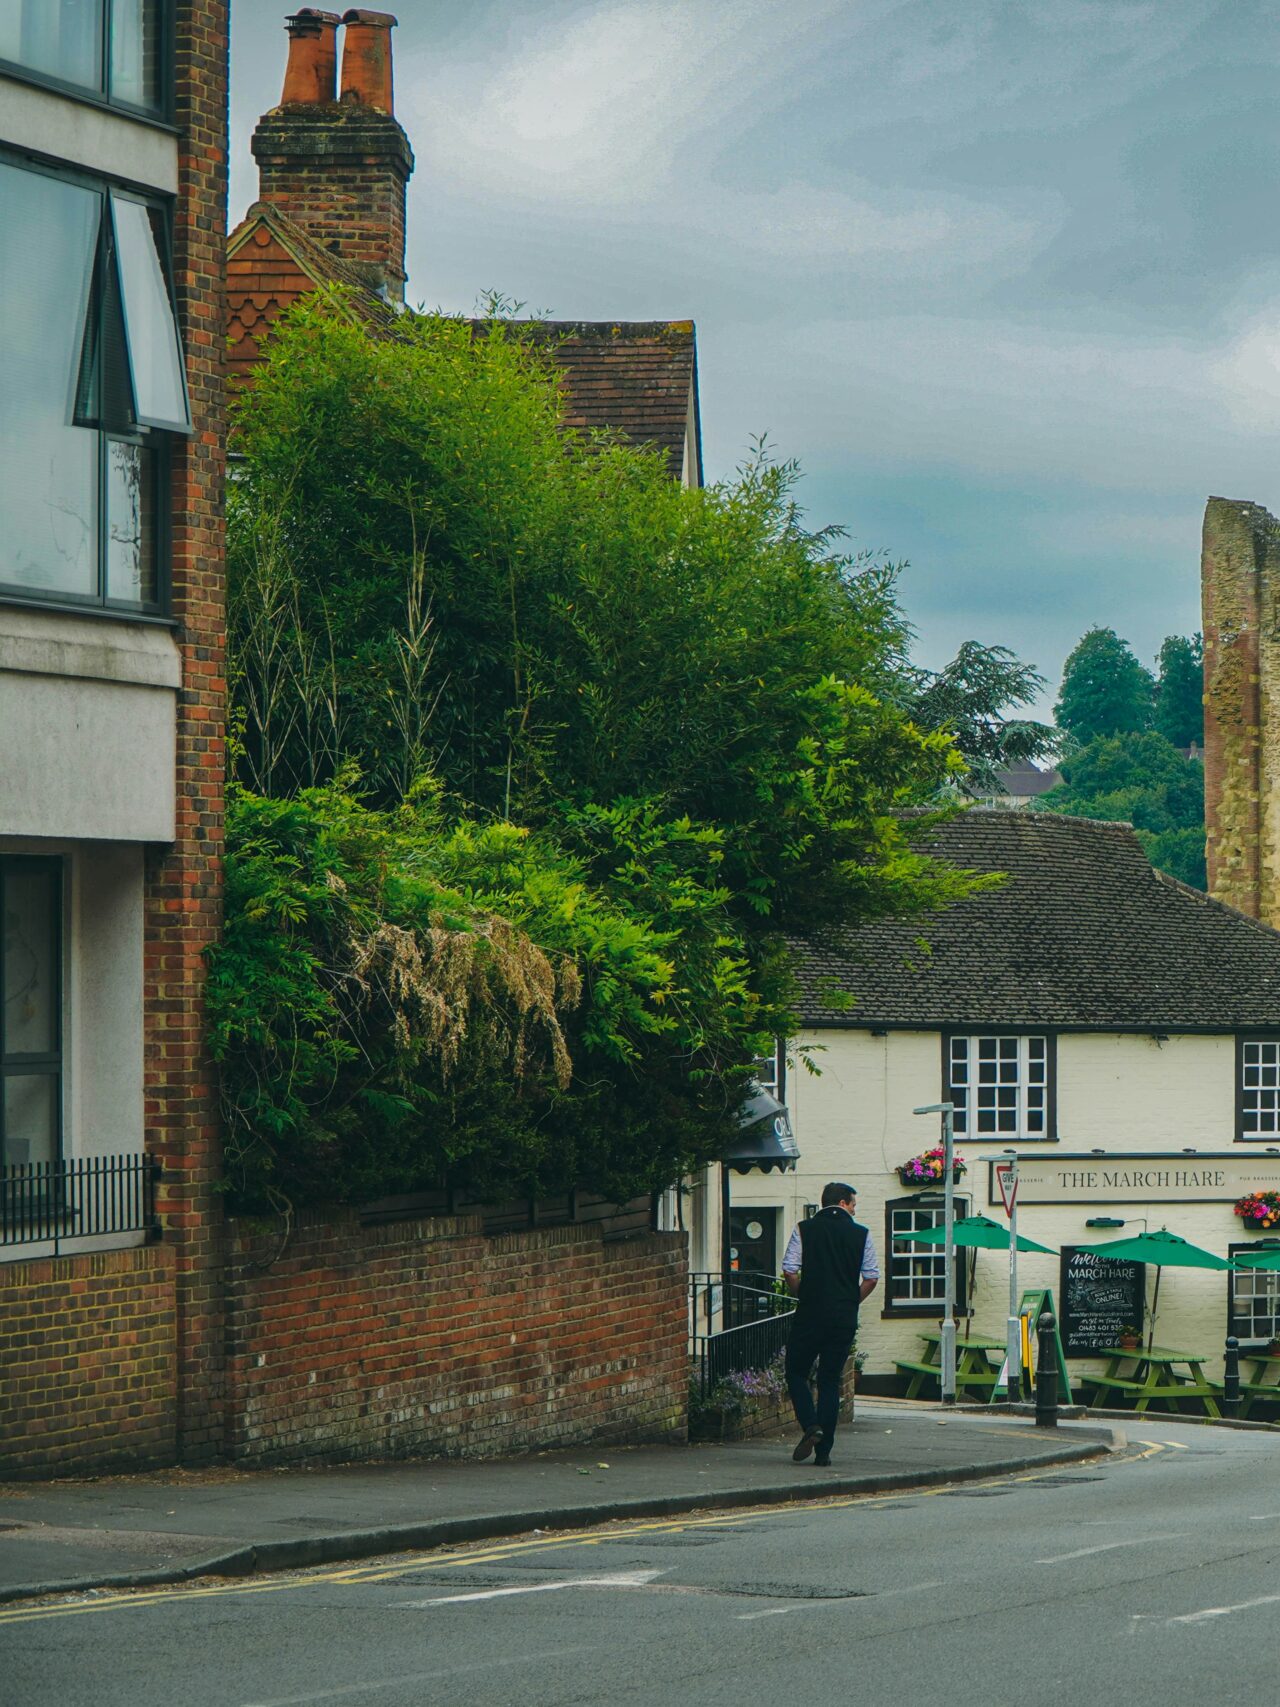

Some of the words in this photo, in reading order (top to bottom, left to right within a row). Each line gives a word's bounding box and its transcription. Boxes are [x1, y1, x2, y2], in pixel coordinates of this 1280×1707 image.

[1002, 1173, 1015, 1183] GIVE
[1057, 1172, 1098, 1188] THE
[1102, 1171, 1170, 1188] MARCH
[1174, 1170, 1226, 1187] HARE
[1068, 1268, 1106, 1280] MARCH
[1109, 1268, 1135, 1280] HARE
[1095, 1293, 1123, 1304] ONLINE!
